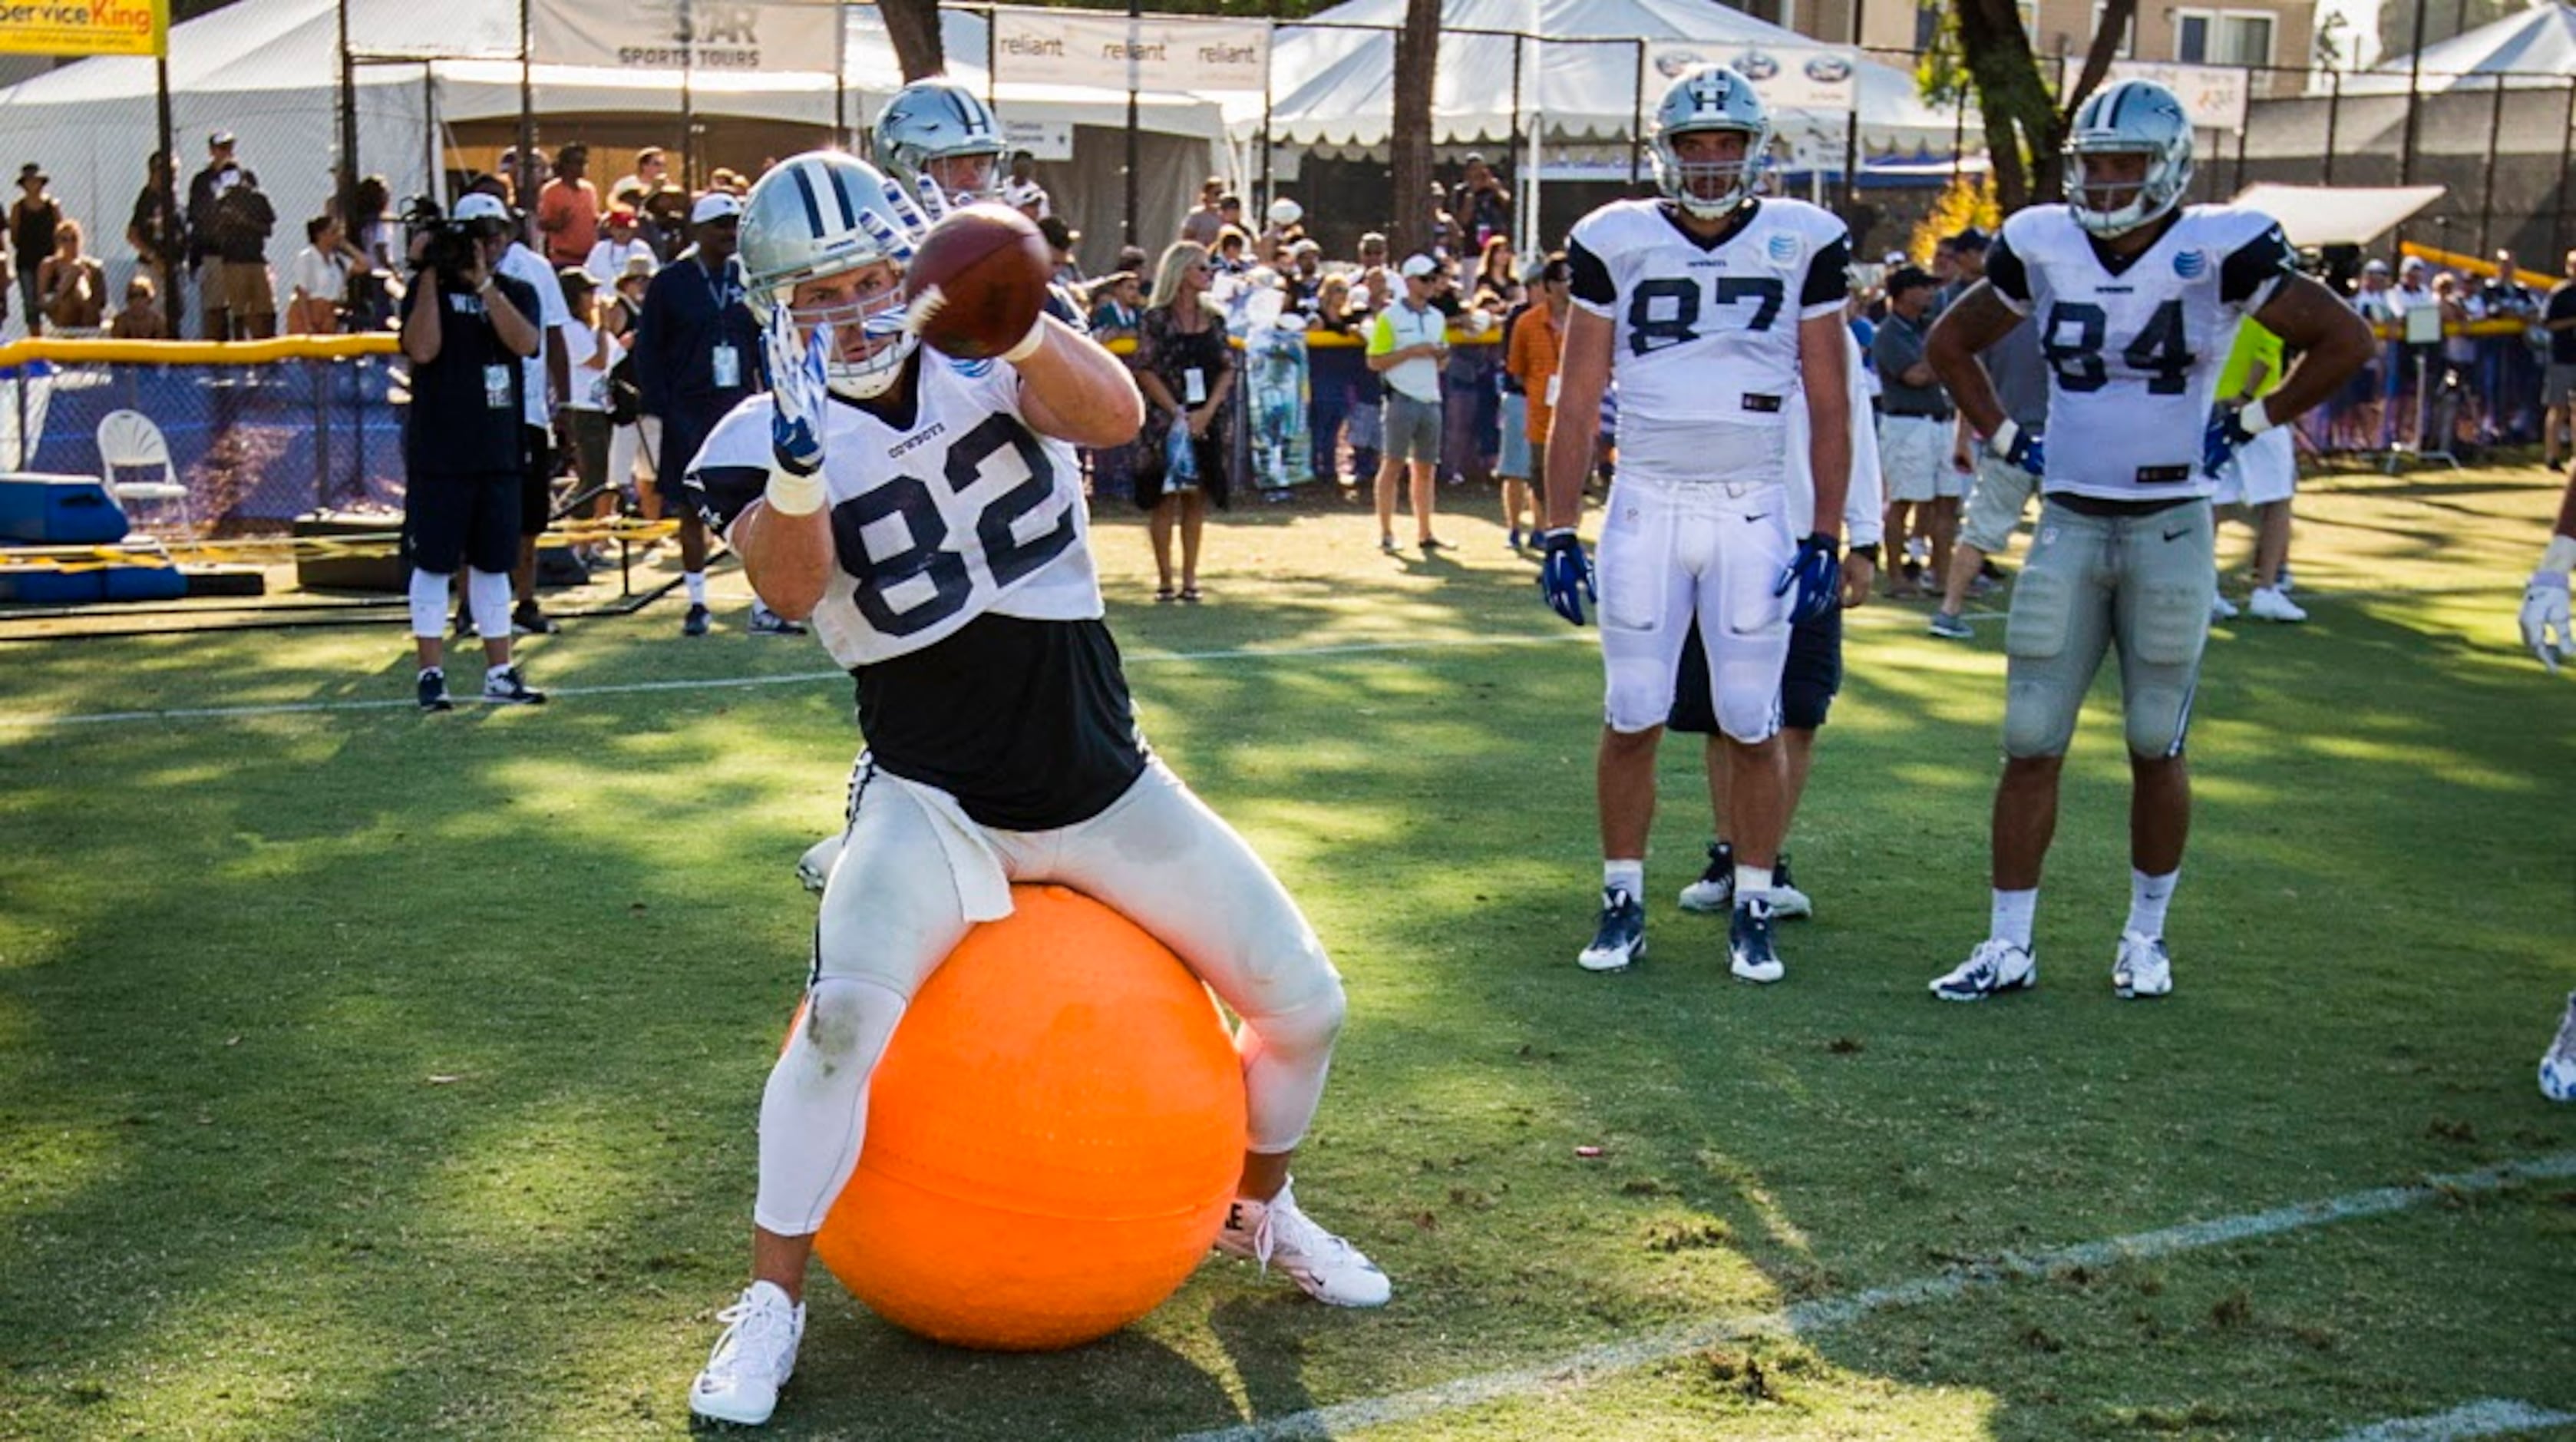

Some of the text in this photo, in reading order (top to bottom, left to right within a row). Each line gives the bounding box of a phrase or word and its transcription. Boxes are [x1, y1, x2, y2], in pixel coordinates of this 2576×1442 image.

[619, 47, 760, 67] SPORTS TOURS
[1000, 34, 1064, 57] reliant
[1102, 40, 1167, 61] reliant
[1198, 43, 1257, 64] reliant
[1627, 276, 1784, 357] 87
[2043, 299, 2197, 395] 84
[888, 422, 945, 458] COWBOYS
[831, 412, 1076, 637] 82
